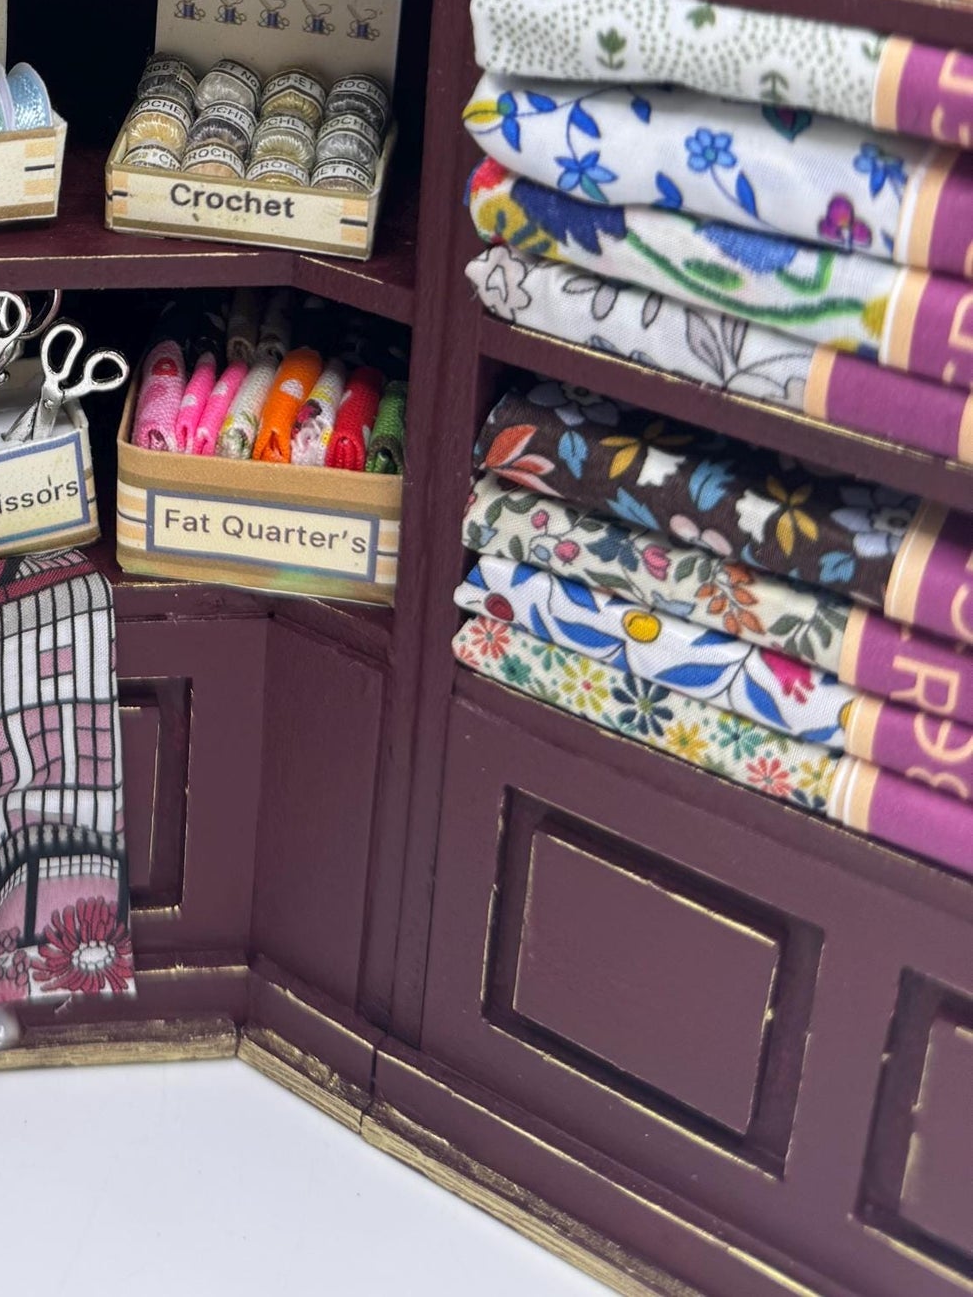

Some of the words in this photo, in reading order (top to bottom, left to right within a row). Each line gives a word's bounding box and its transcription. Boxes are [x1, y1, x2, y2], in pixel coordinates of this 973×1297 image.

[170, 182, 295, 219] Crochet
[164, 508, 210, 534] Fat
[221, 514, 368, 554] Quarter's
